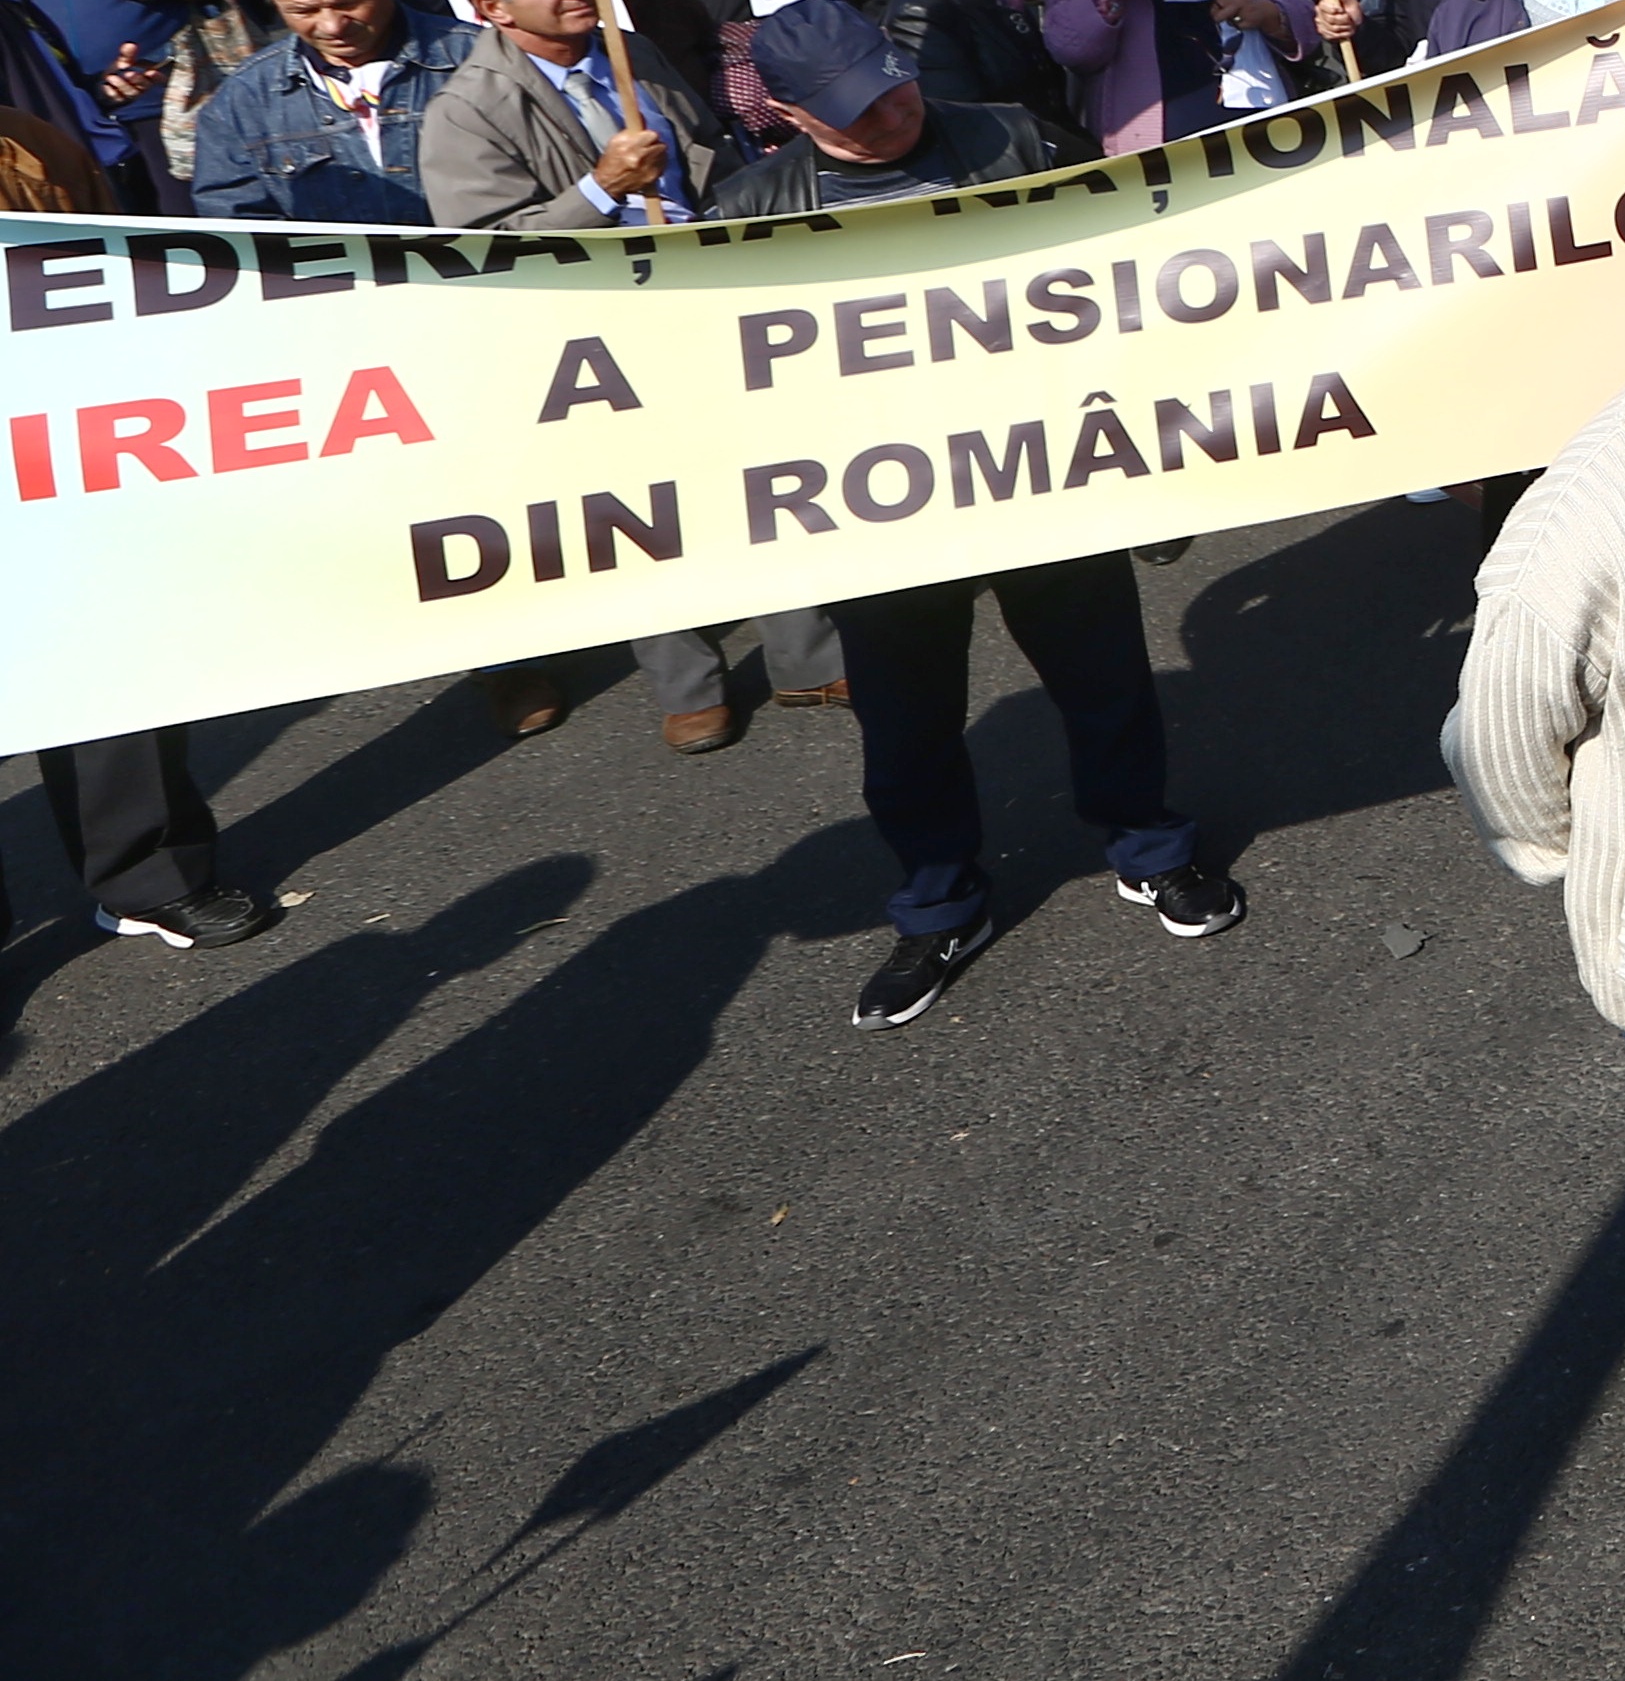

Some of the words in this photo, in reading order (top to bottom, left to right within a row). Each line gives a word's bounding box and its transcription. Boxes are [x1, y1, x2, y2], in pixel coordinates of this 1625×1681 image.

[9, 365, 436, 502] IREA
[537, 336, 643, 424] A
[410, 479, 685, 604] DIN
[742, 371, 1378, 545] ROMÂNIA
